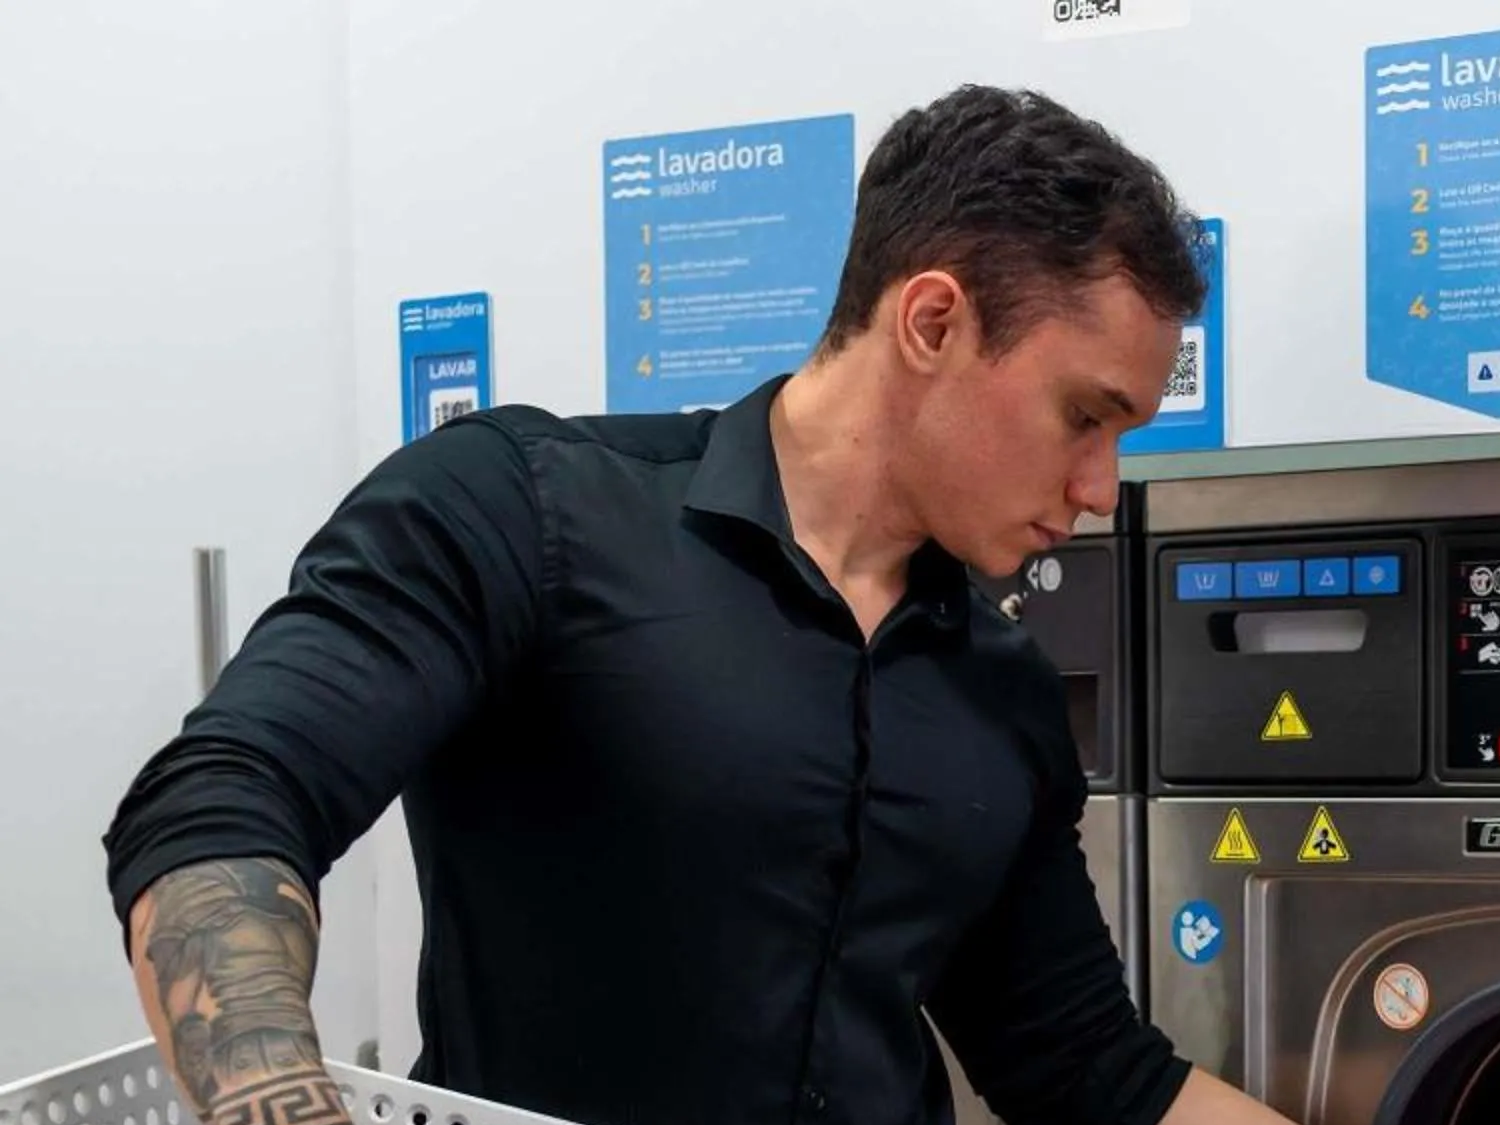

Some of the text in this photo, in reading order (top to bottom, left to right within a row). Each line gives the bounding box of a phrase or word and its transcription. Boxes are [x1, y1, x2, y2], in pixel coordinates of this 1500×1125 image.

[658, 139, 784, 178] lavadora
[1415, 142, 1429, 168] 1
[659, 176, 717, 199] washer
[1410, 188, 1430, 213] 2
[640, 225, 652, 246] 1
[1410, 229, 1429, 256] 3
[638, 264, 653, 285] 2
[425, 301, 485, 321] lavadora
[638, 301, 652, 321] 3
[1408, 295, 1431, 320] 4
[429, 358, 477, 380] LAVAR
[636, 355, 653, 378] 4
